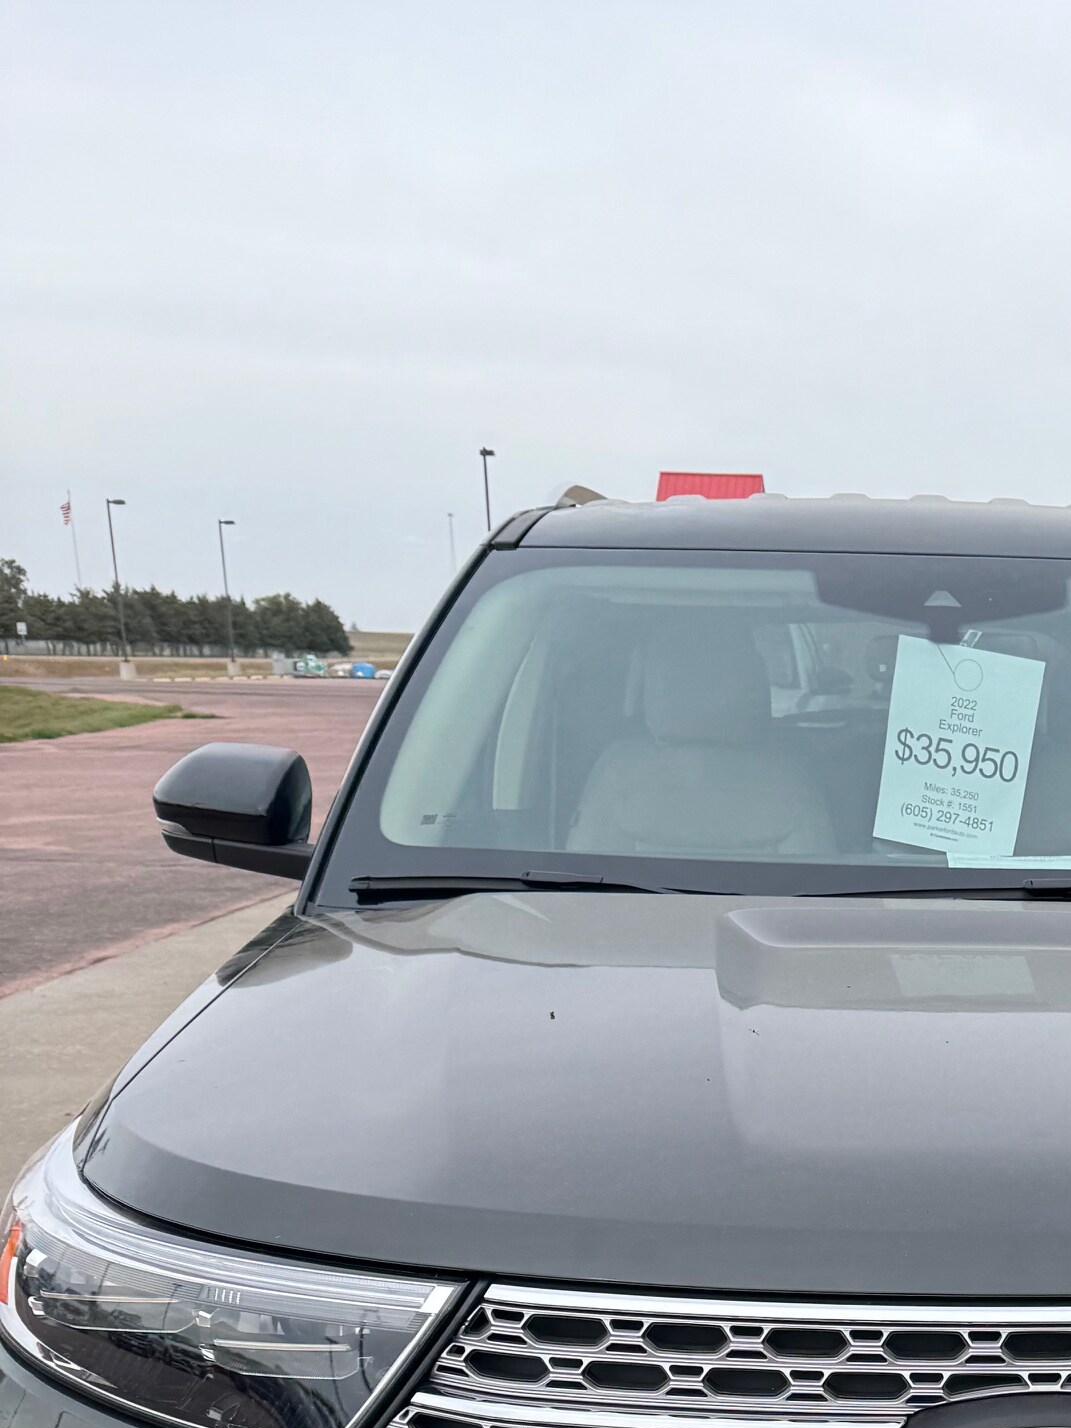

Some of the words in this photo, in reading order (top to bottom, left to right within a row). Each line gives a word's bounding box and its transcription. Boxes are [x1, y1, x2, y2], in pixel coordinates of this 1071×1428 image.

[950, 696, 978, 711] 2022
[950, 709, 975, 723] Ford
[938, 719, 983, 738] Explorer
[895, 727, 1019, 783] $35,950
[924, 782, 949, 795] Miles:
[950, 787, 979, 801] 35,250
[921, 794, 944, 807] Stock
[958, 802, 977, 813] 1551
[901, 802, 933, 822] (605)
[936, 809, 994, 832] 297-4851
